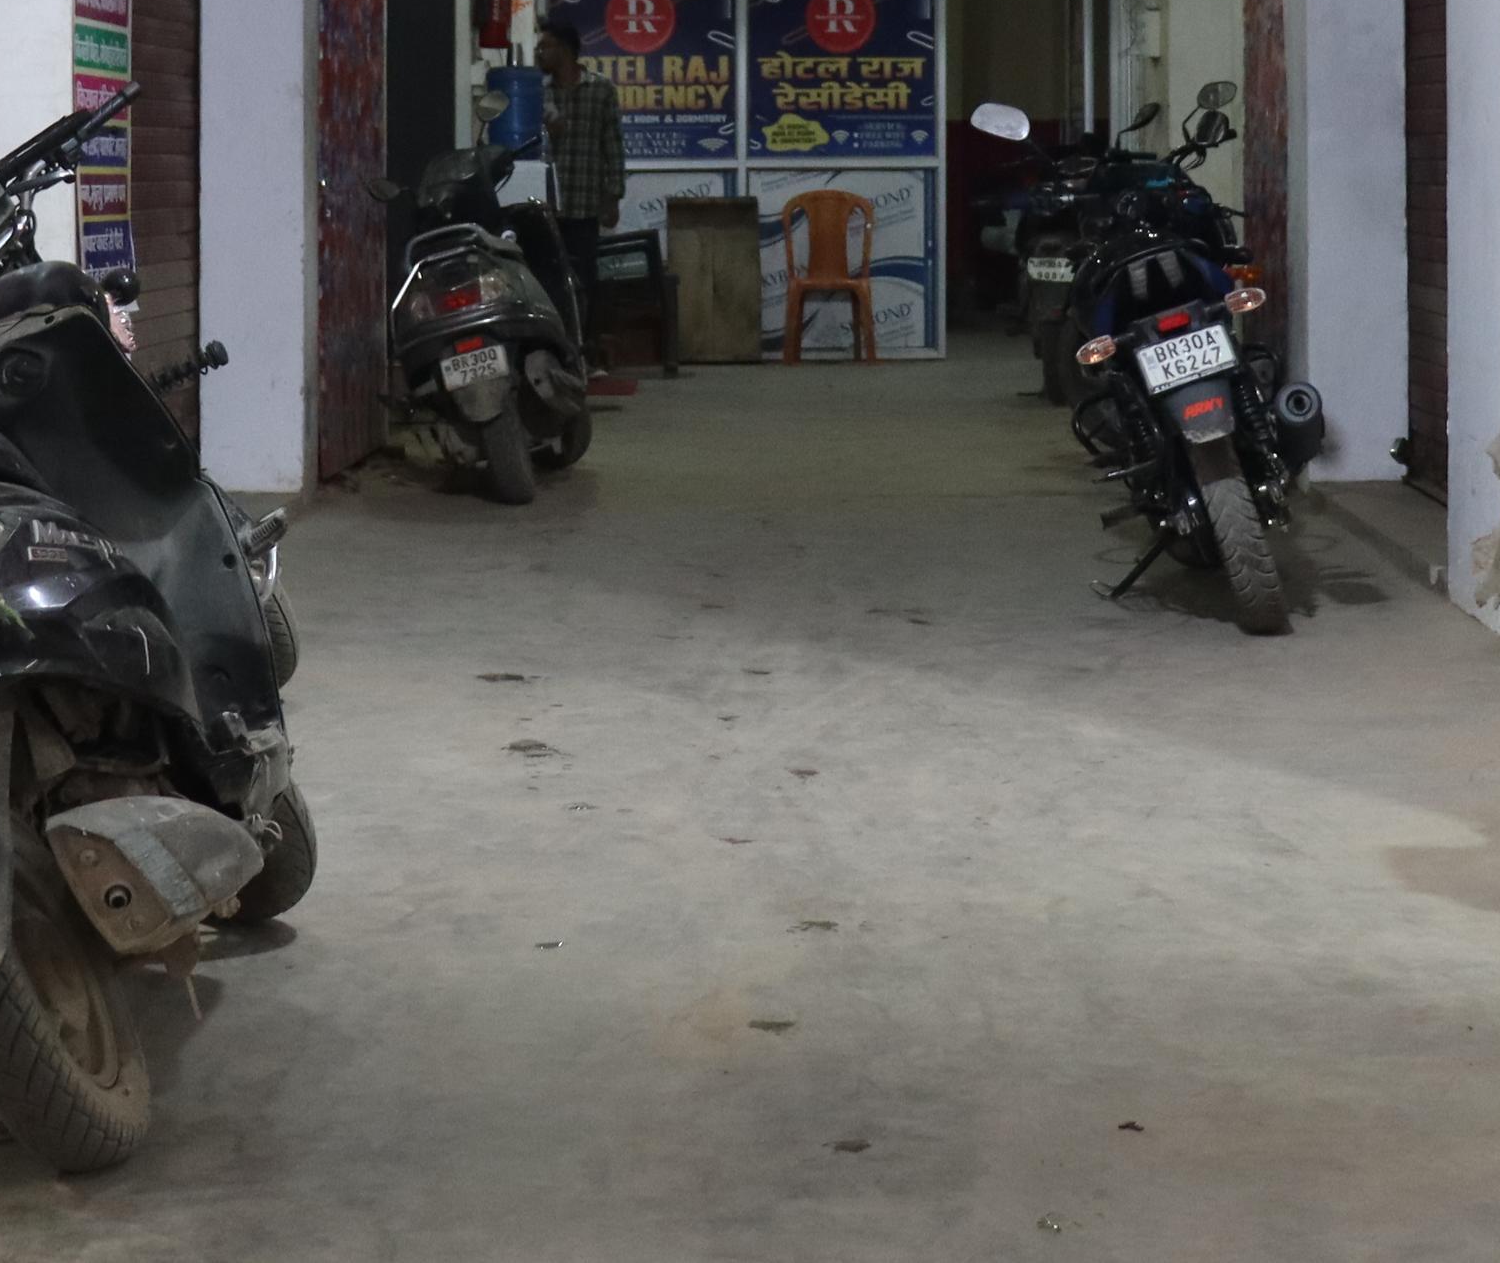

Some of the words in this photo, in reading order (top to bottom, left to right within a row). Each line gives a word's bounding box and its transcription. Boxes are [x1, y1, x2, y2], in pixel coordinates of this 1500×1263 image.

[576, 54, 648, 83] OTEL
[661, 54, 731, 83] RAJ
[756, 50, 854, 80] होटल
[856, 56, 927, 80] राज
[1153, 330, 1218, 363] BR30A
[1161, 346, 1222, 380] K6247
